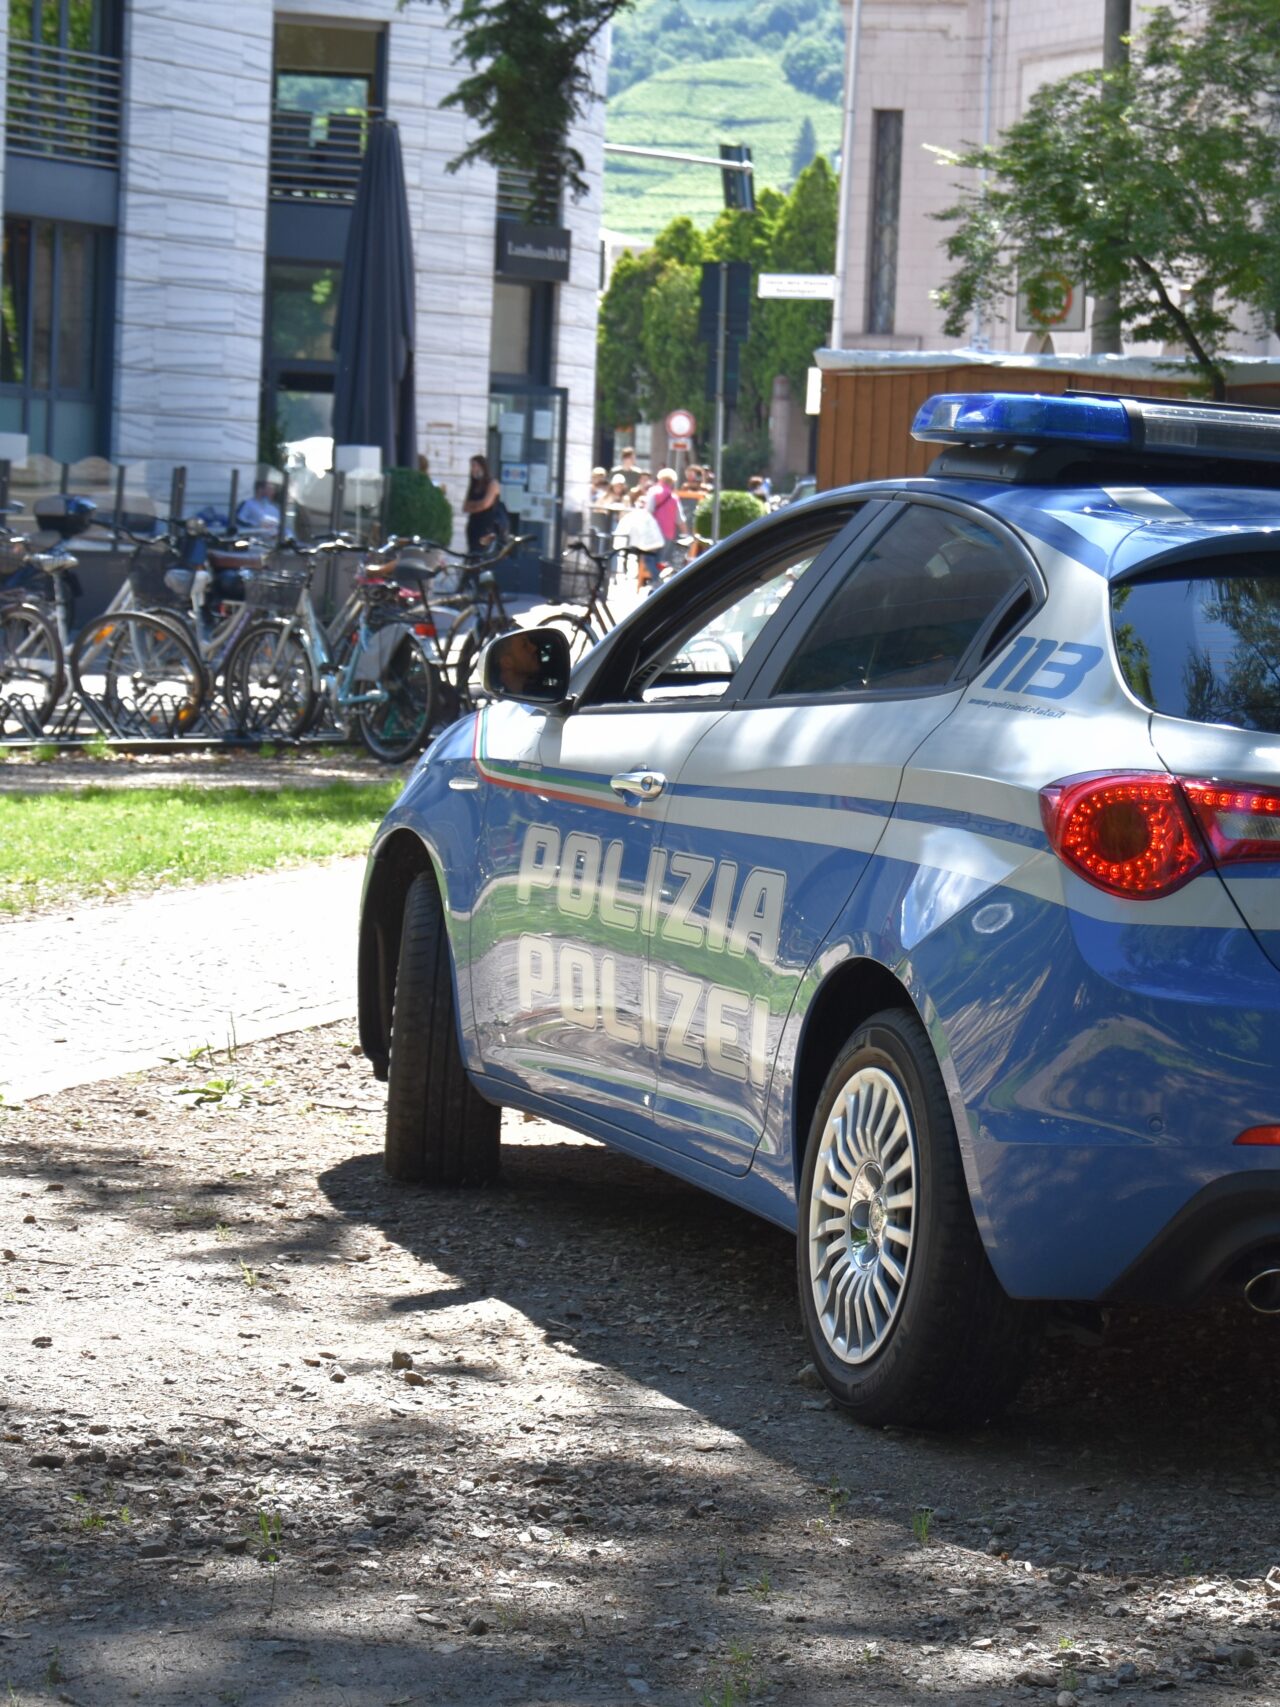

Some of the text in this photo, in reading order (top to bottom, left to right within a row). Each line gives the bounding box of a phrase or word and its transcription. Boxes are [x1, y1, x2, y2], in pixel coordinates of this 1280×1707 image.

[982, 635, 1104, 700] 113
[515, 822, 788, 963] POLIZIA
[517, 931, 770, 1090] POLIZEI
